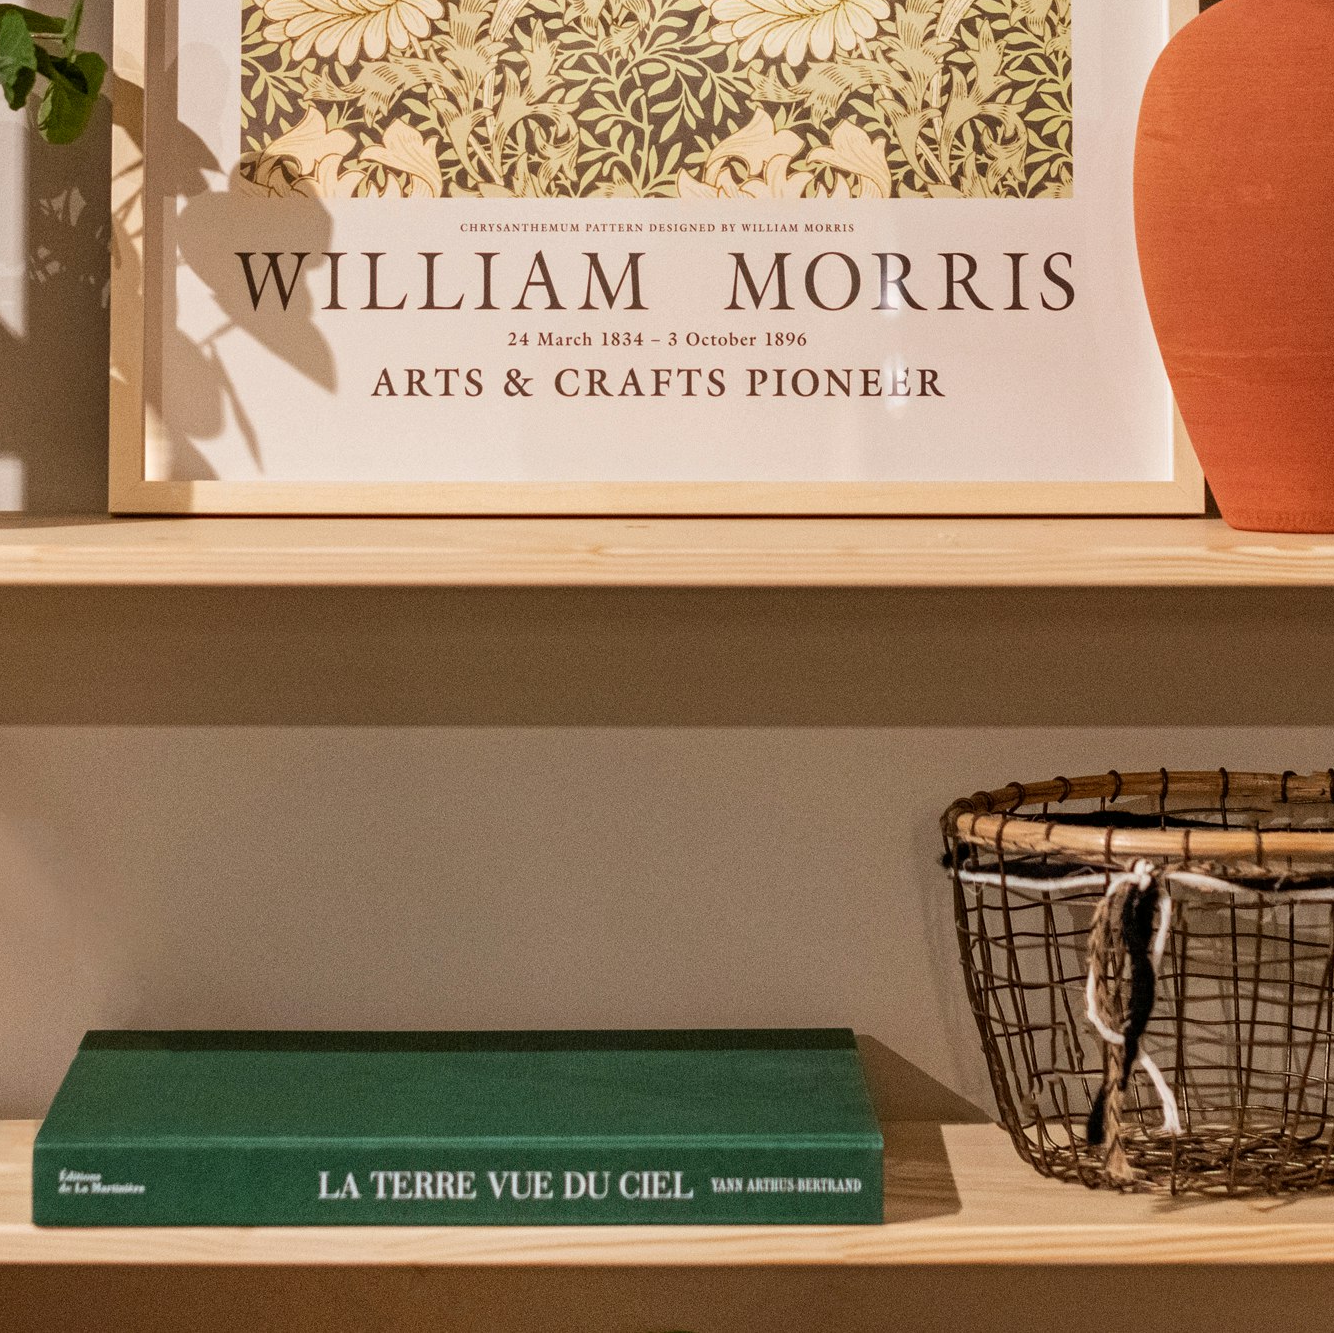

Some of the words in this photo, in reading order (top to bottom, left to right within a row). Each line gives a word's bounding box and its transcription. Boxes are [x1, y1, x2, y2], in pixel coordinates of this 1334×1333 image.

[459, 223, 581, 233] CHRYSANTHEMUM
[585, 223, 644, 233] PATTERN
[648, 223, 716, 233] DESIGNED
[720, 223, 737, 233] BY
[741, 223, 800, 233] WILLIAM
[803, 223, 856, 233] MORRIS
[233, 250, 651, 312] WILLIAM
[723, 250, 1076, 312] MORRIS
[507, 331, 531, 347] 24
[537, 330, 594, 347] March
[601, 331, 645, 347] 1834
[667, 331, 679, 348] 3
[685, 330, 758, 348] October
[764, 331, 809, 347] 1896
[370, 367, 484, 398] ARTS
[502, 367, 534, 398] &
[553, 367, 727, 398] CRAFTS
[745, 367, 946, 398] PIONEER
[317, 1170, 362, 1201] LA
[370, 1170, 478, 1201] TERRE
[486, 1170, 555, 1201] VUE
[562, 1170, 611, 1201] DU
[618, 1170, 696, 1201] CIEL
[710, 1176, 744, 1193] YANN
